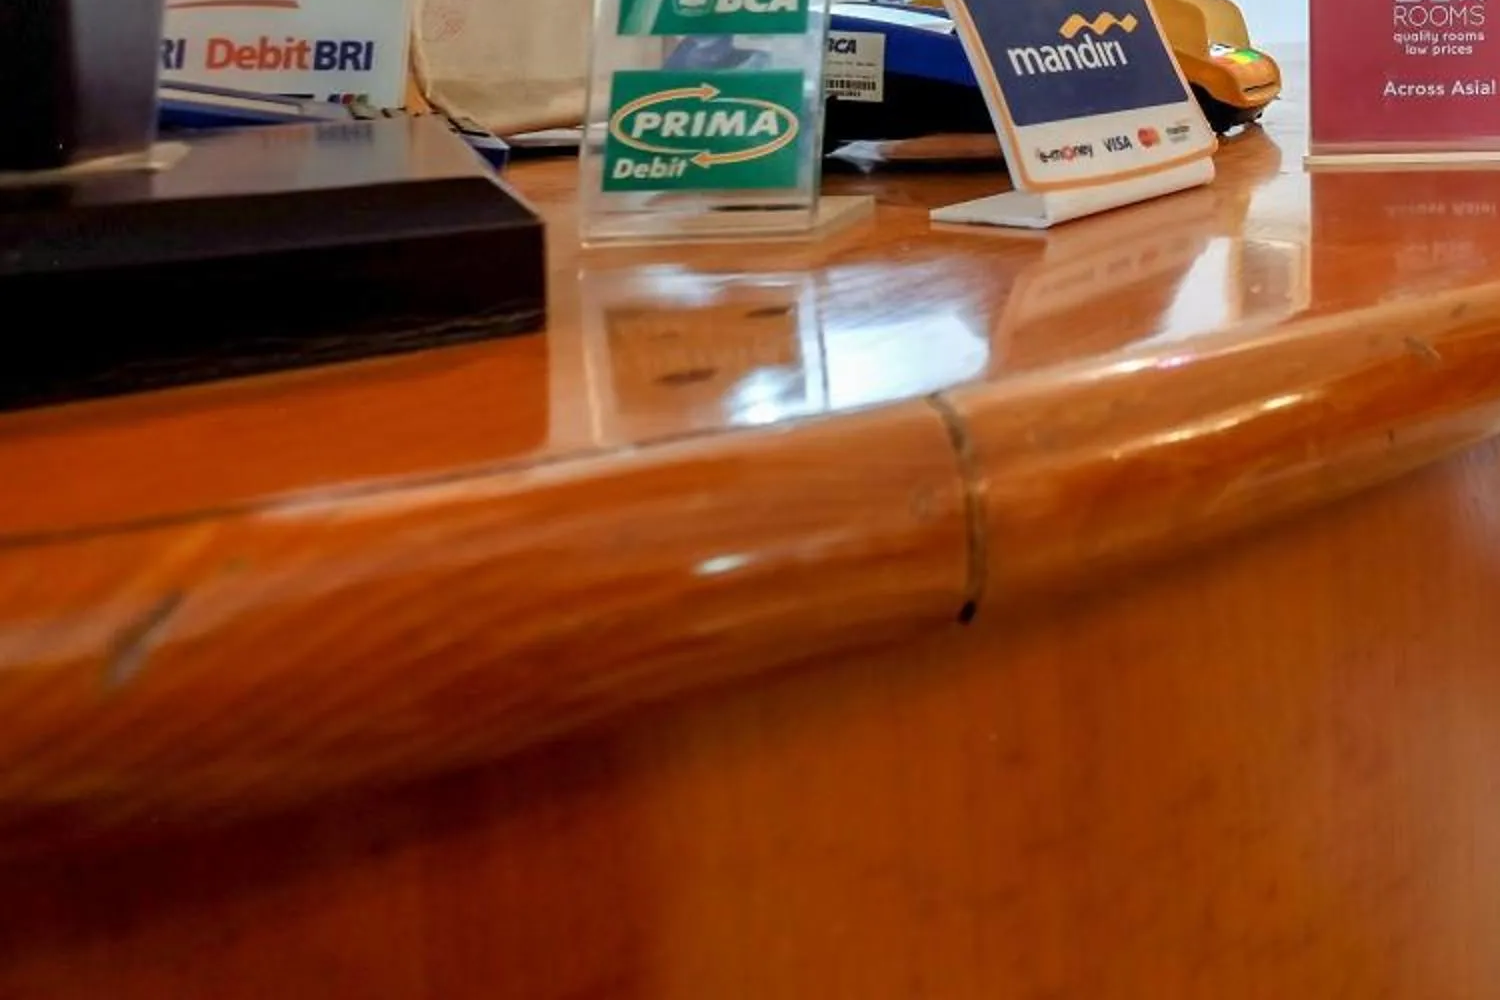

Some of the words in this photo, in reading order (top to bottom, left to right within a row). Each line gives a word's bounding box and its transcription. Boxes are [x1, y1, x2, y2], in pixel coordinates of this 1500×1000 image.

[1393, 5, 1486, 27] ROOMS
[1393, 30, 1440, 44] quality
[1443, 32, 1485, 42] rooms
[1007, 35, 1128, 76] mandiri
[1404, 44, 1428, 56] low
[1431, 44, 1473, 57] prices
[1383, 80, 1445, 96] Across
[1451, 79, 1498, 96] Asia!
[631, 109, 779, 138] PRIMA
[1103, 135, 1133, 153] VISA
[612, 156, 688, 180] Debit
